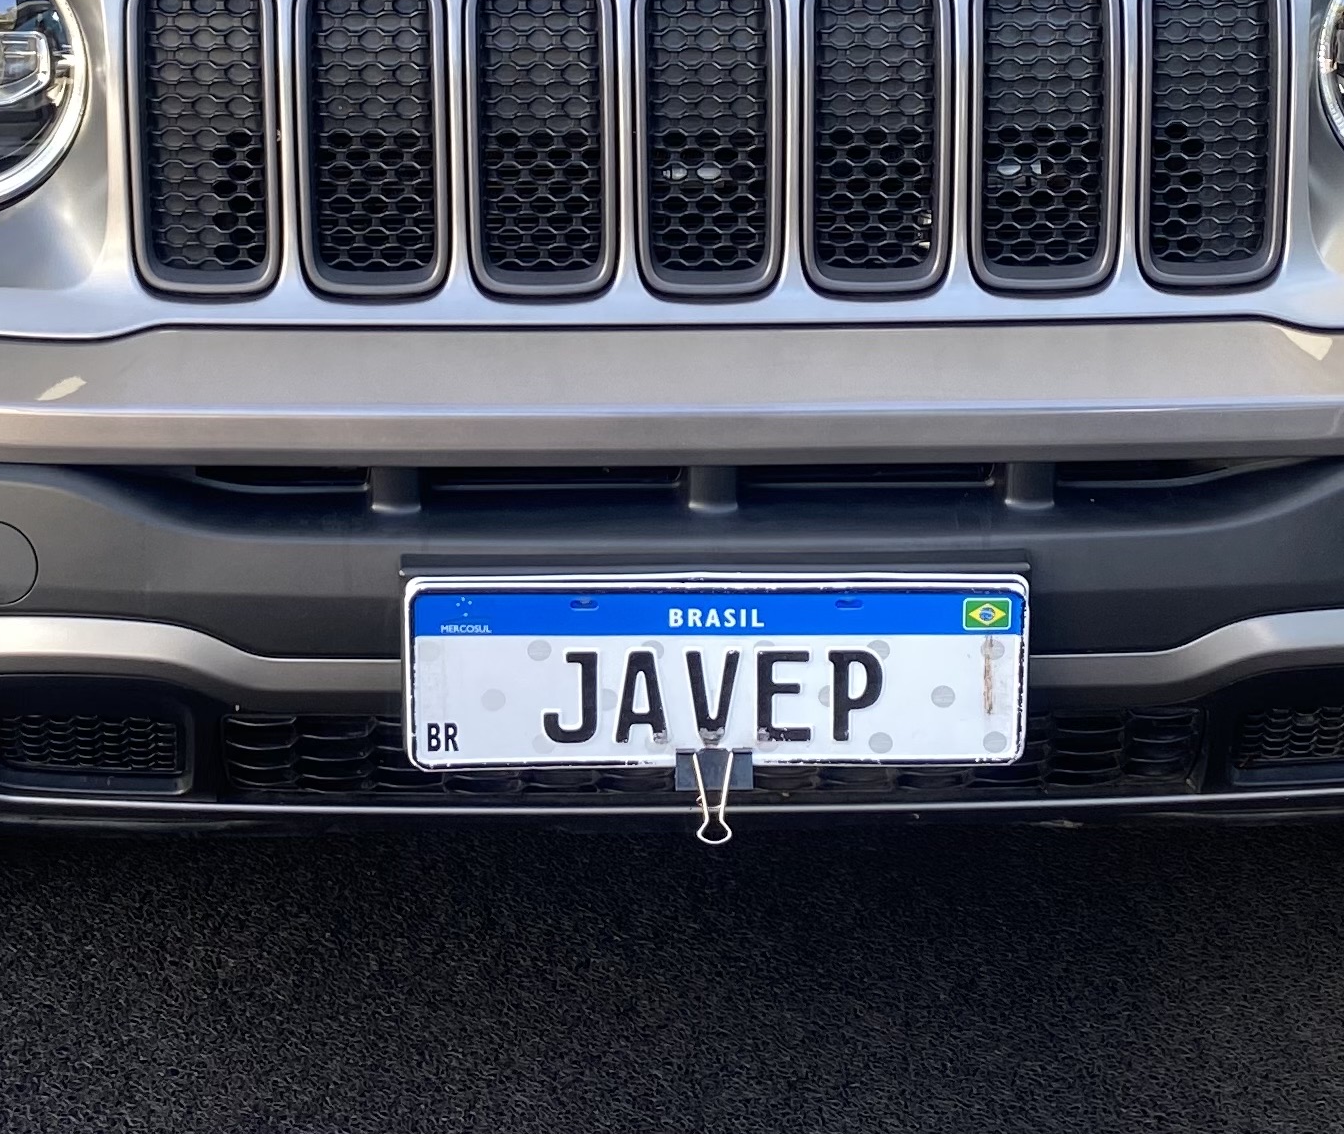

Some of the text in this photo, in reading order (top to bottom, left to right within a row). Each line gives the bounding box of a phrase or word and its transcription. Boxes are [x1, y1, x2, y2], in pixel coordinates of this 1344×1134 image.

[440, 624, 492, 634] MERCOSUL
[668, 609, 765, 628] BRASIL
[543, 649, 884, 746] JAVEP
[427, 722, 459, 752] BR
